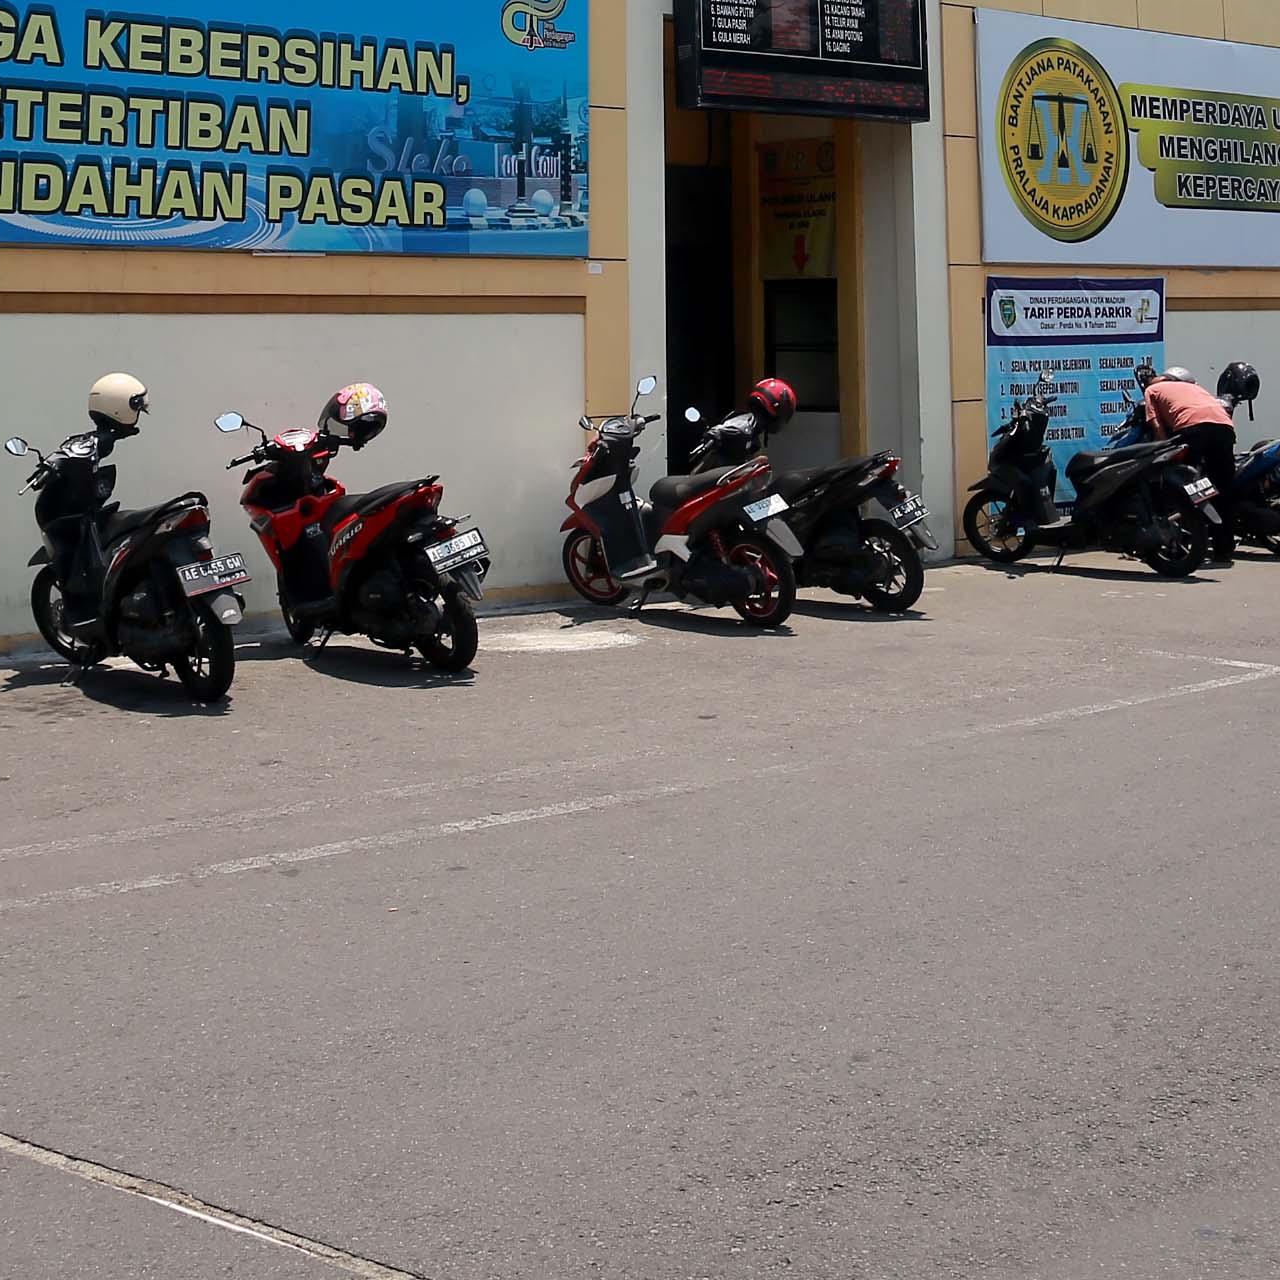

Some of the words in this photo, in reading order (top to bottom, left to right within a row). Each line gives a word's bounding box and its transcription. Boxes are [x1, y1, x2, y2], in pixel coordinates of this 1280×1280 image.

[716, 4, 738, 17] BAWANG
[739, 7, 754, 18] PUTIH
[717, 17, 732, 29] GULA
[732, 19, 747, 30] PASIR
[718, 31, 732, 43] GULA
[733, 33, 751, 45] MERAH
[85, 18, 469, 105] KEBERSIHAN,
[1008, 57, 1055, 128] BANTJANA
[1057, 57, 1113, 135] PATAKARAN
[1130, 94, 1268, 130] MEMPERDAYA
[1009, 143, 1050, 215] PRALAJA
[1052, 151, 1114, 222] KAPRADANAN
[268, 176, 447, 228] PASAR
[1029, 297, 1047, 305] DINAS
[1047, 297, 1089, 305] PERDAGANGAN
[1105, 296, 1126, 304] MADIUN
[1023, 307, 1054, 319] TARIF
[1057, 307, 1091, 319] PERDA
[1095, 306, 1132, 319] PARKIR
[185, 568, 200, 581] AE
